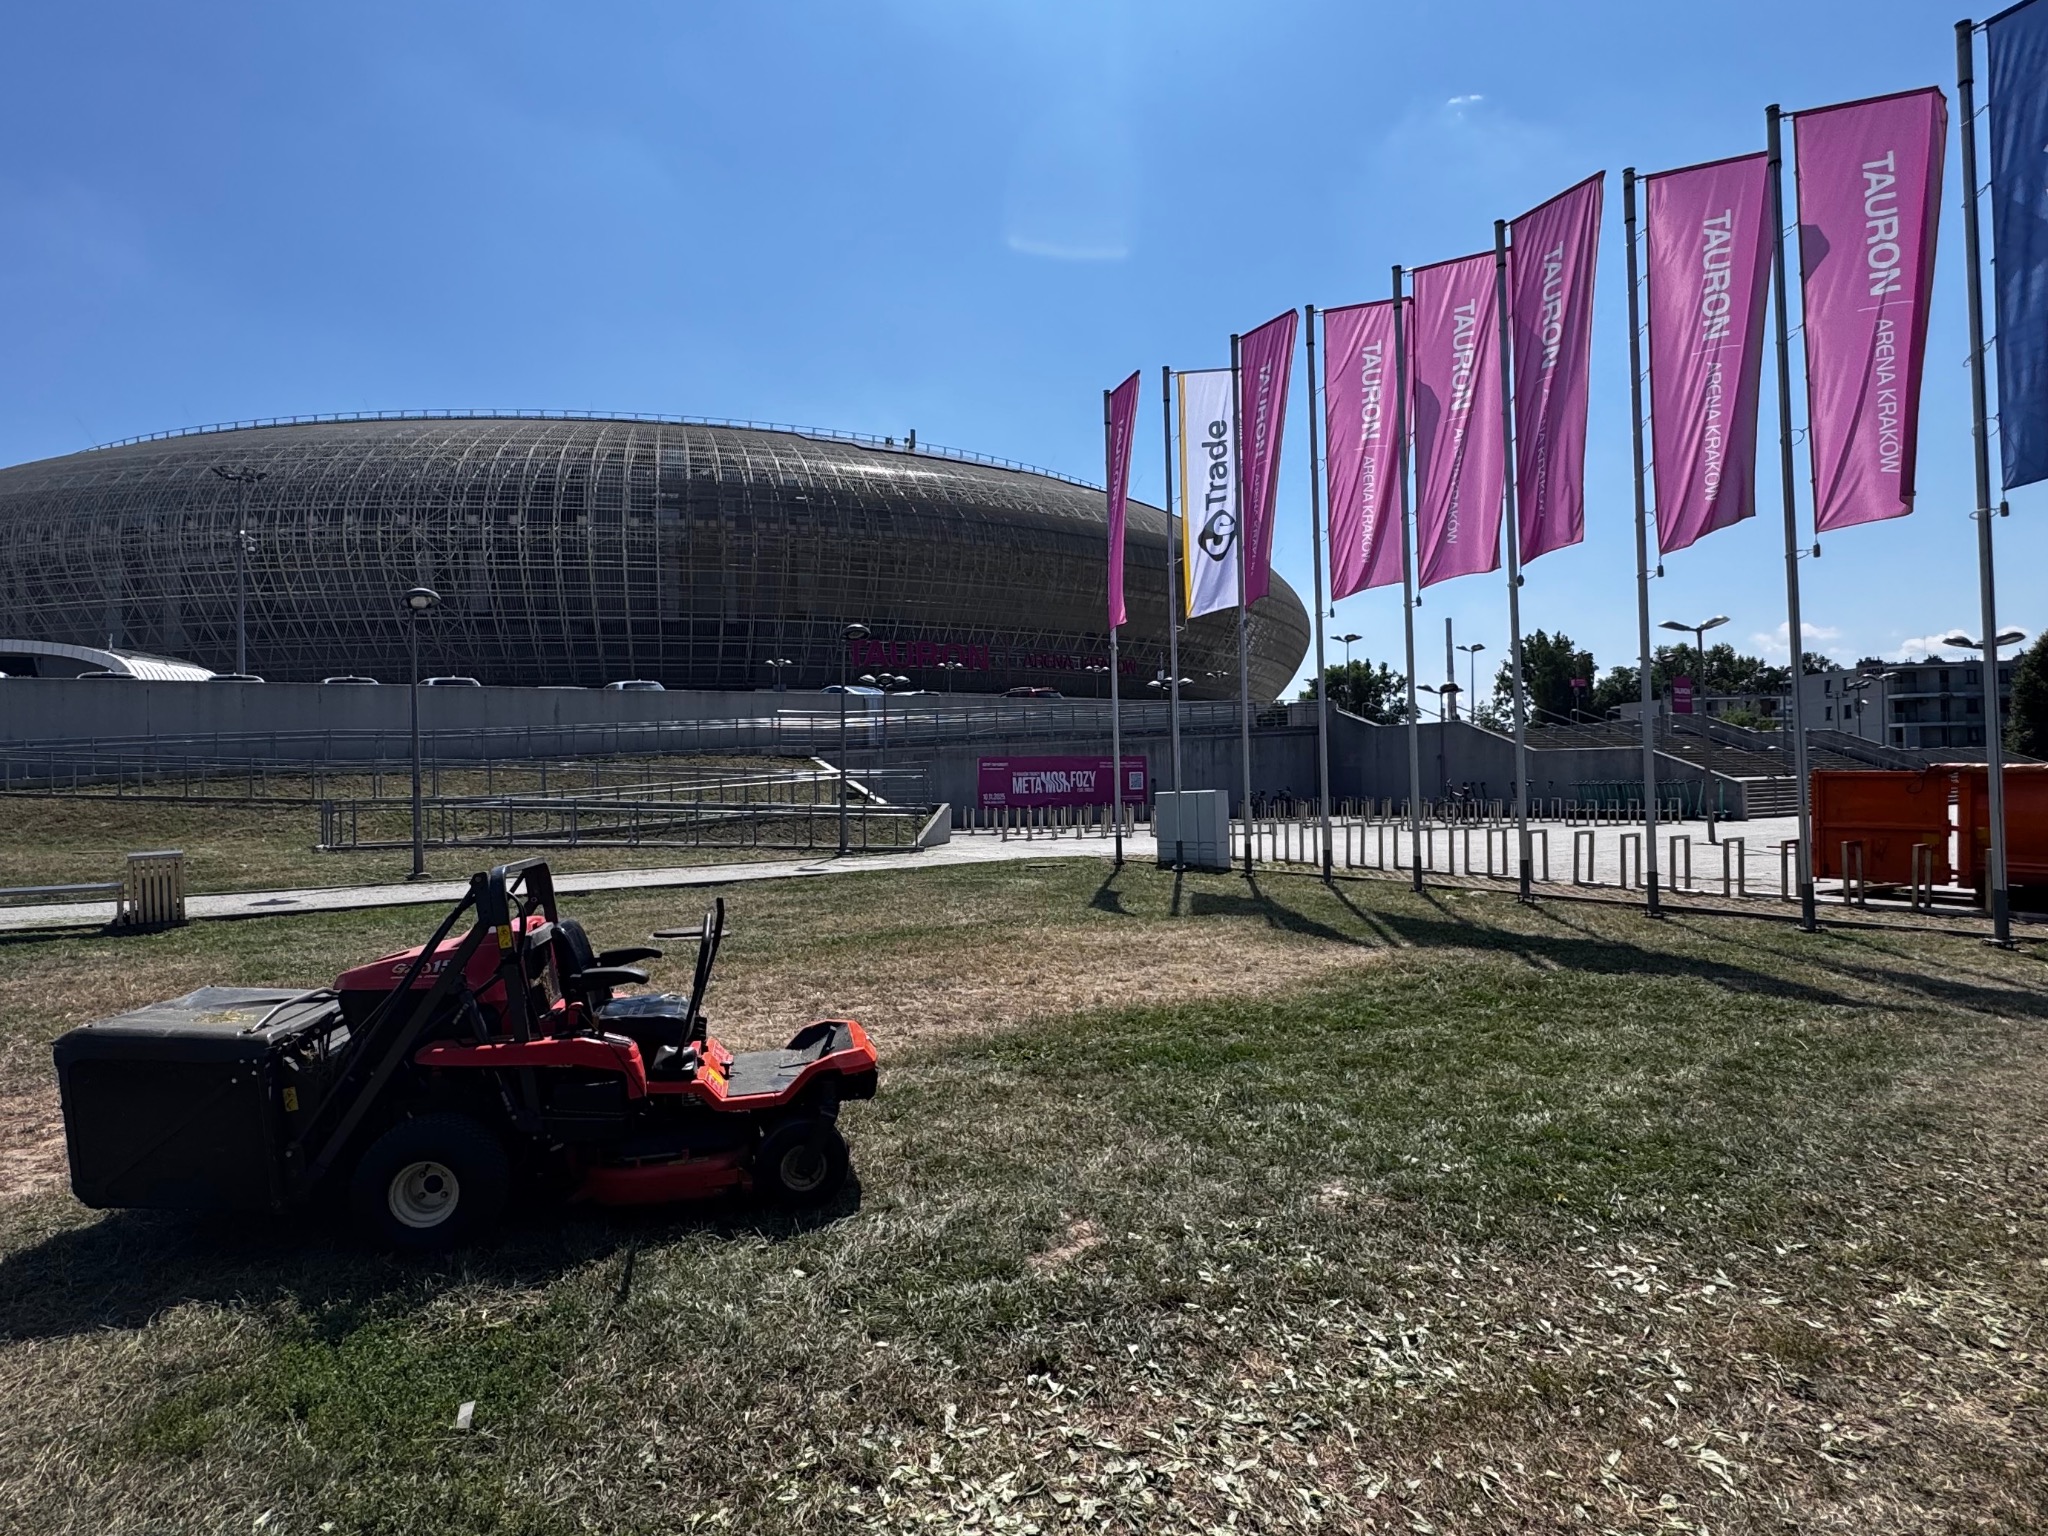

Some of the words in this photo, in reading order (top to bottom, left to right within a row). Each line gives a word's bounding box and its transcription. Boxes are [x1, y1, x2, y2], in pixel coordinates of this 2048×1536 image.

[1862, 150, 1902, 297] TAURON
[1541, 240, 1564, 370] TAURON
[1702, 208, 1731, 341] TAURON
[1361, 339, 1382, 441] TAURON
[1450, 298, 1476, 411] TAURON
[1704, 361, 1722, 420] ARENA
[1874, 319, 1896, 386] ARENA
[1254, 358, 1272, 459] TAURON
[1876, 389, 1903, 474] KRAKÓW
[1201, 419, 1228, 511] Trade
[1362, 456, 1375, 503] ARENA
[851, 639, 989, 672] TAURON
